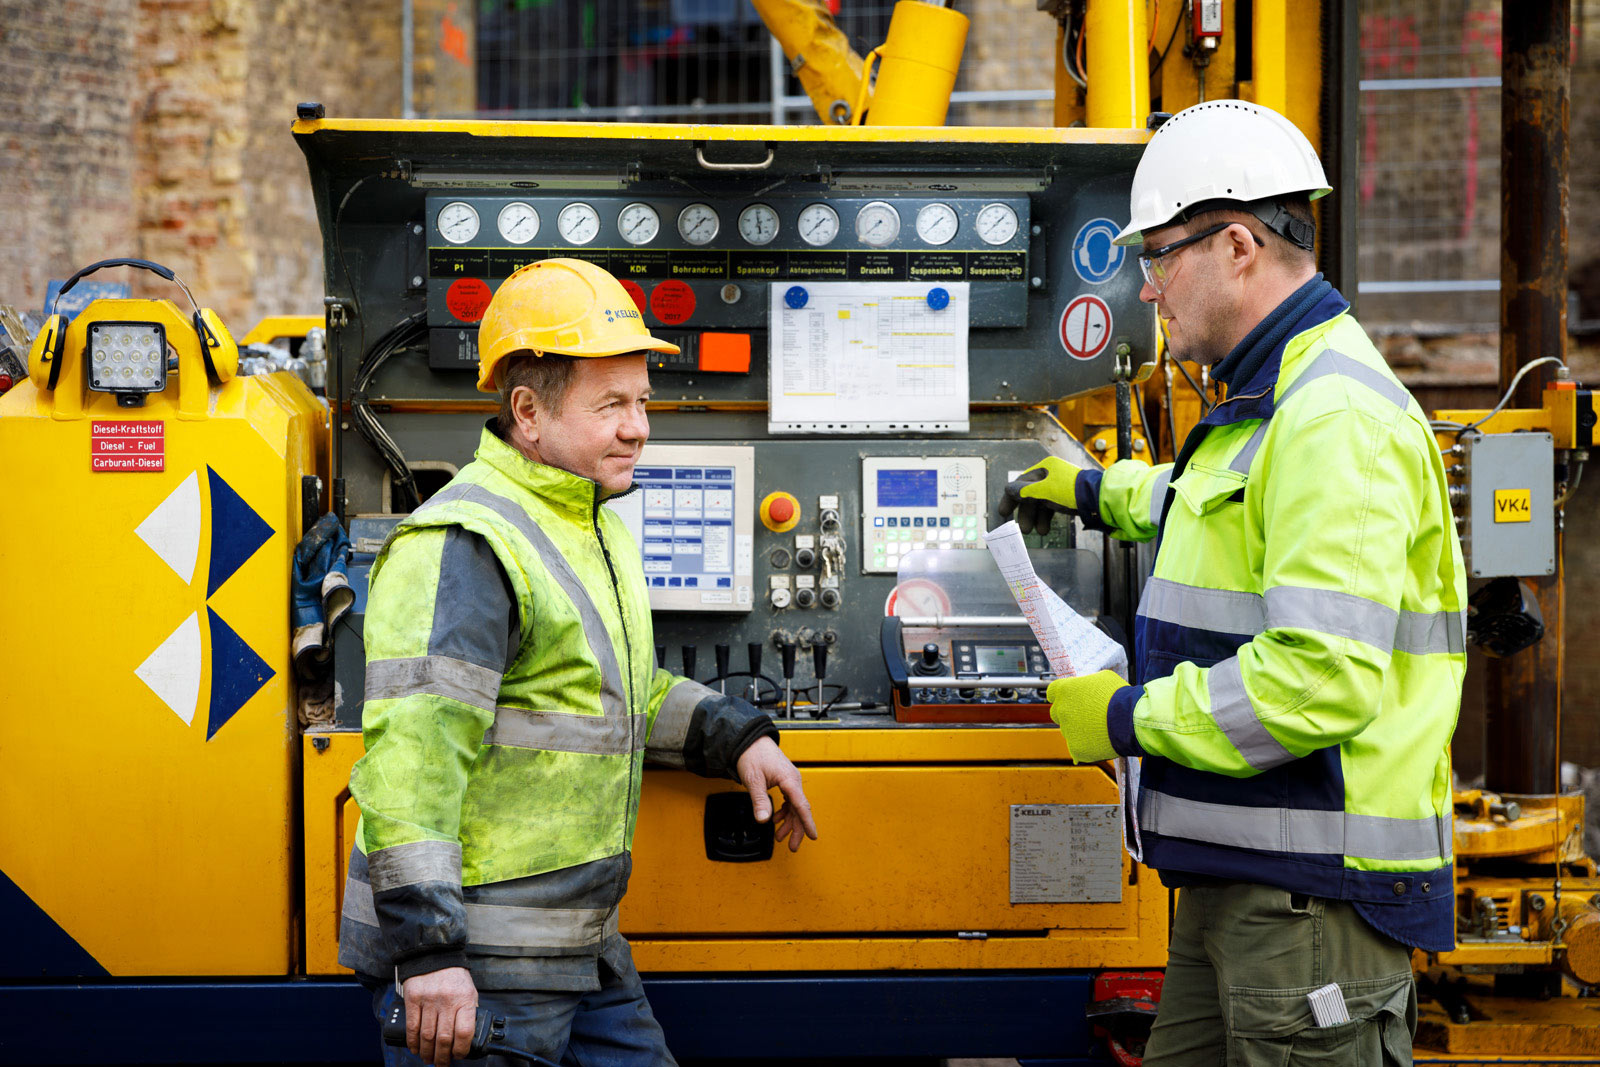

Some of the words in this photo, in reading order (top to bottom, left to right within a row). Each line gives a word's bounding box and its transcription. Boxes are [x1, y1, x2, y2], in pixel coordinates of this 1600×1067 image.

[454, 264, 464, 272] P1
[630, 265, 647, 273] KDK
[673, 265, 723, 274] Bohrandruck
[737, 266, 779, 275] Spannkopf
[860, 266, 894, 275] Druckluft
[910, 266, 963, 276] Suspension-ND
[461, 311, 478, 319] 2017
[664, 313, 681, 321] 2017
[93, 424, 162, 434] Diesel-Kraftstoff
[100, 441, 125, 451] Diesel
[138, 441, 156, 451] Fuel
[93, 458, 163, 467] Carburant-Diesel
[1497, 498, 1529, 512] VK4
